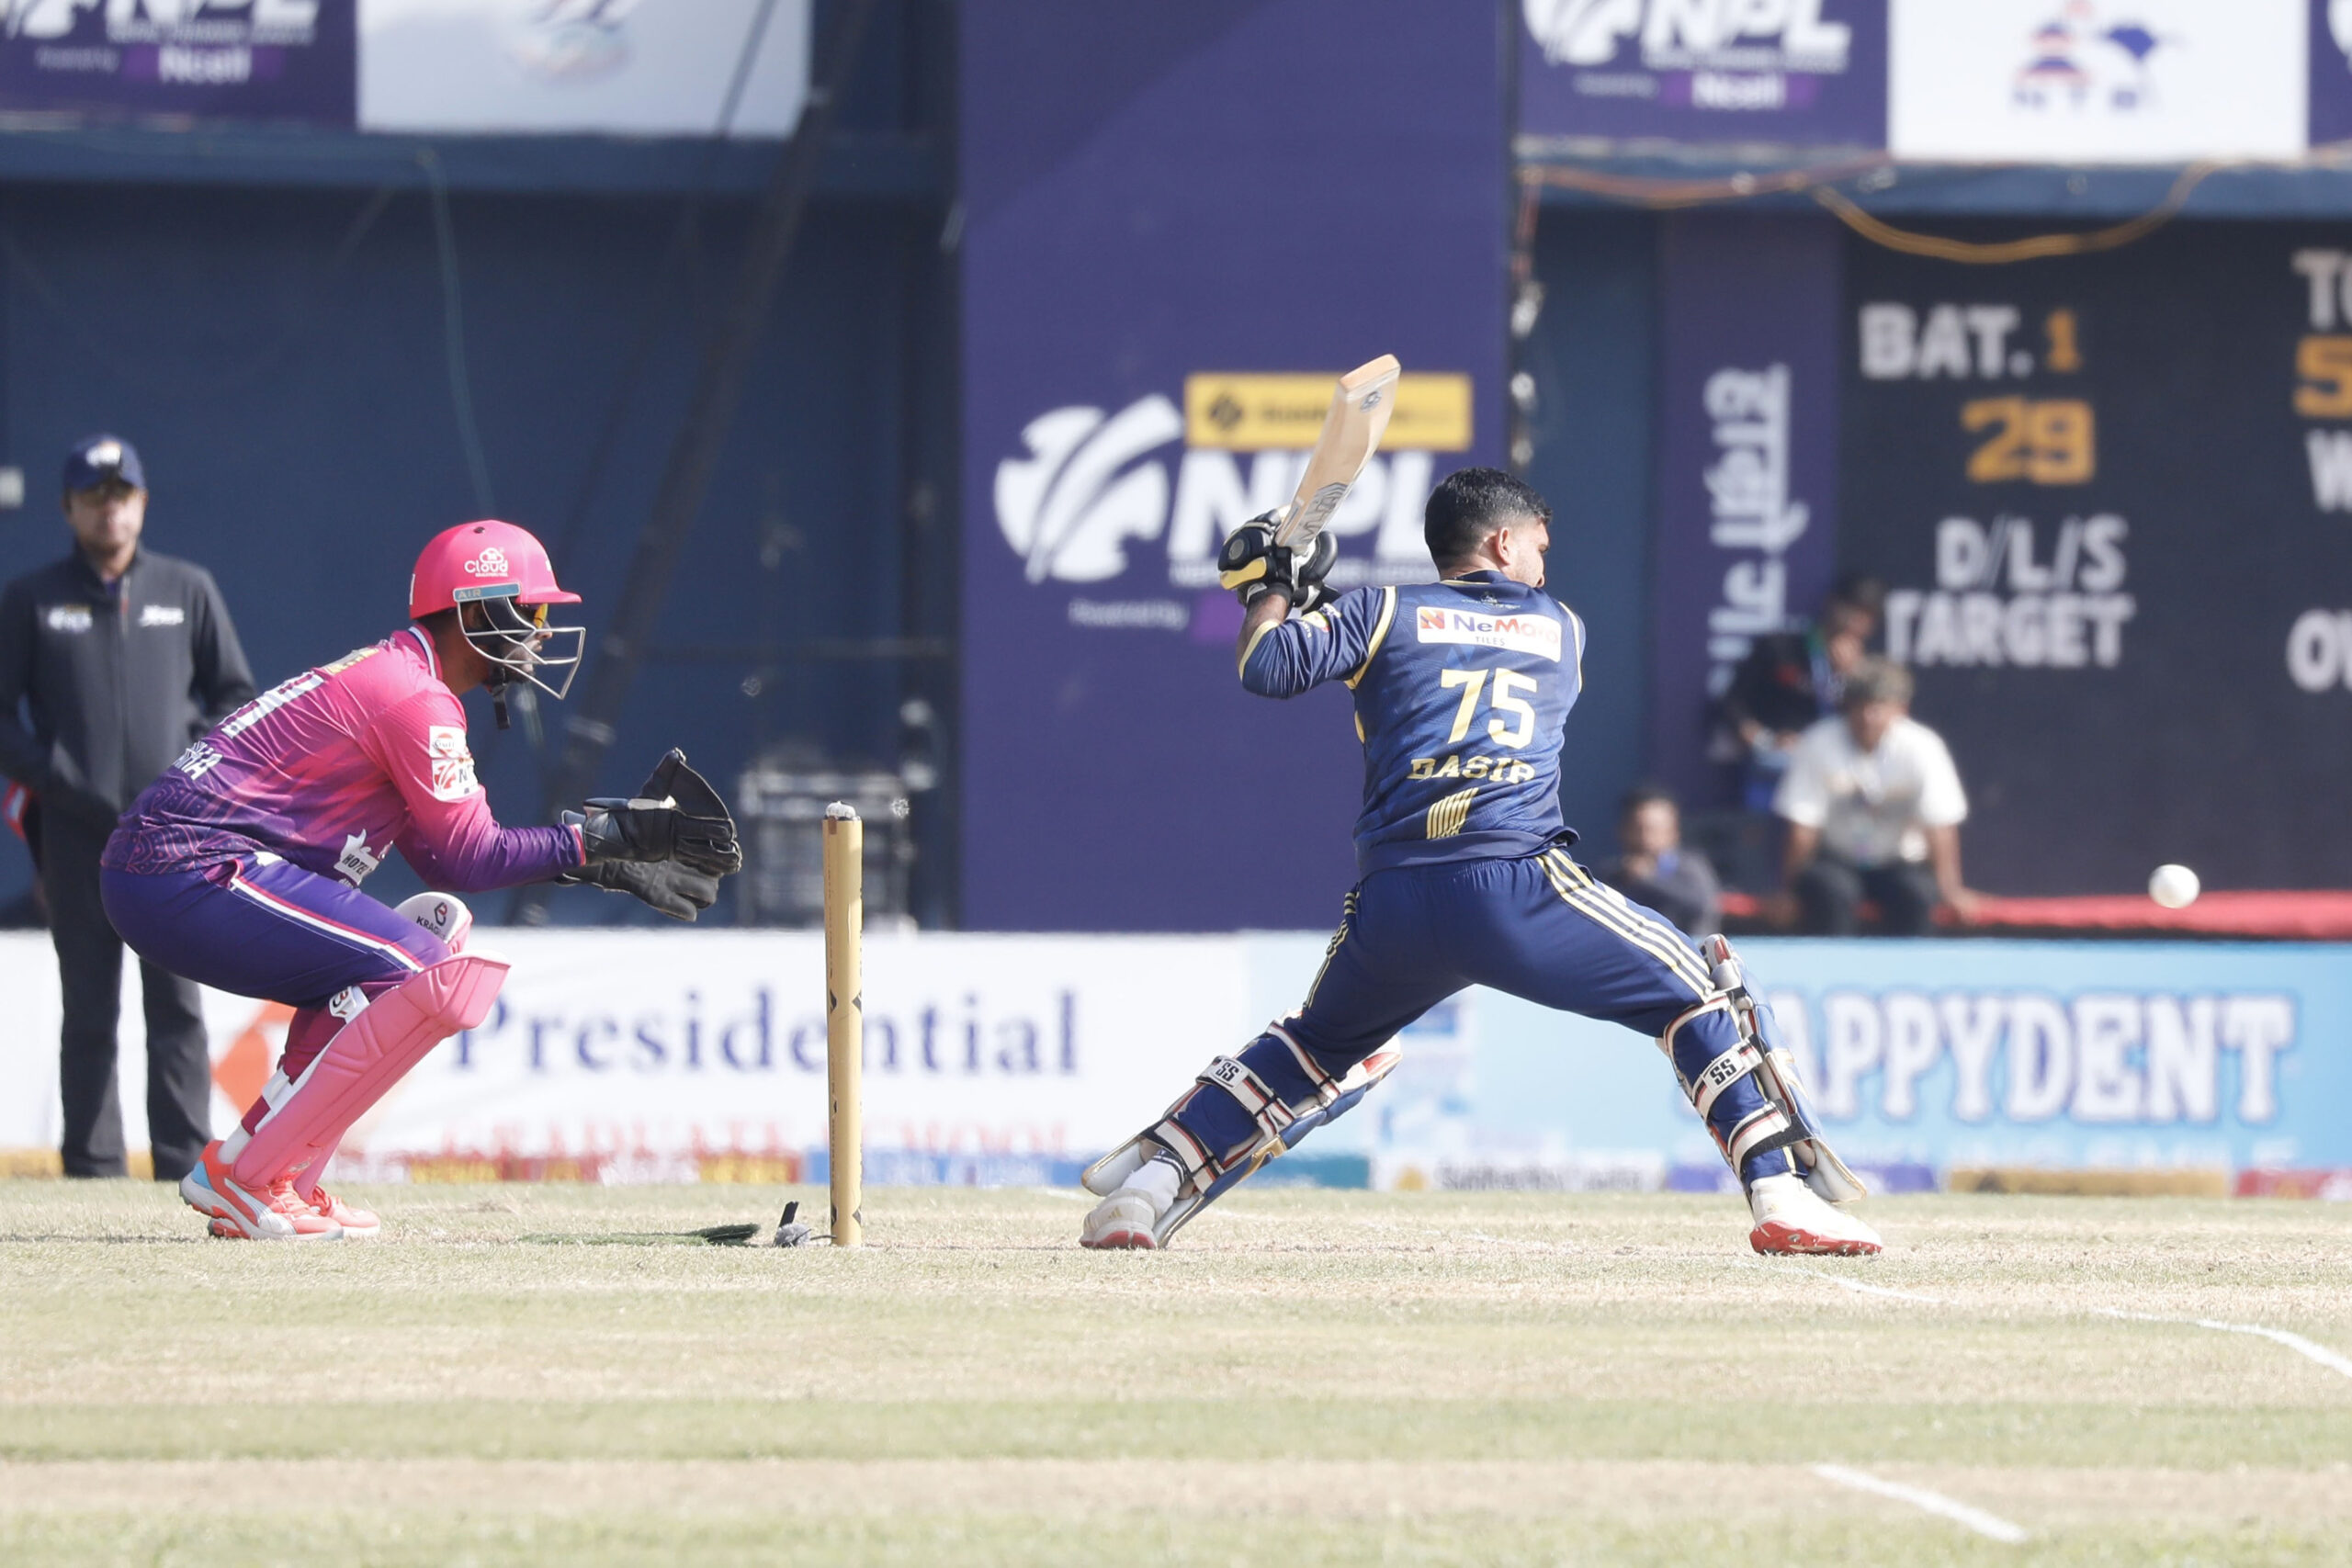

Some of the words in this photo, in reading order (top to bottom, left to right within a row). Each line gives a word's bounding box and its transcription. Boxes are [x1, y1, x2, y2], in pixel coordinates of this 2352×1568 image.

[1860, 303, 2032, 378] BAT.
[1961, 395, 2095, 484] 29
[464, 559, 509, 574] Cloud
[1935, 514, 2130, 591] D/L/S
[458, 589, 481, 599] AIR
[1884, 590, 2136, 668] TARGET
[1475, 636, 1506, 648] TILES
[1441, 668, 1538, 750] 75
[453, 986, 1078, 1075] Presidential
[1215, 1061, 1240, 1082] SS
[1709, 1058, 1737, 1086] SS
